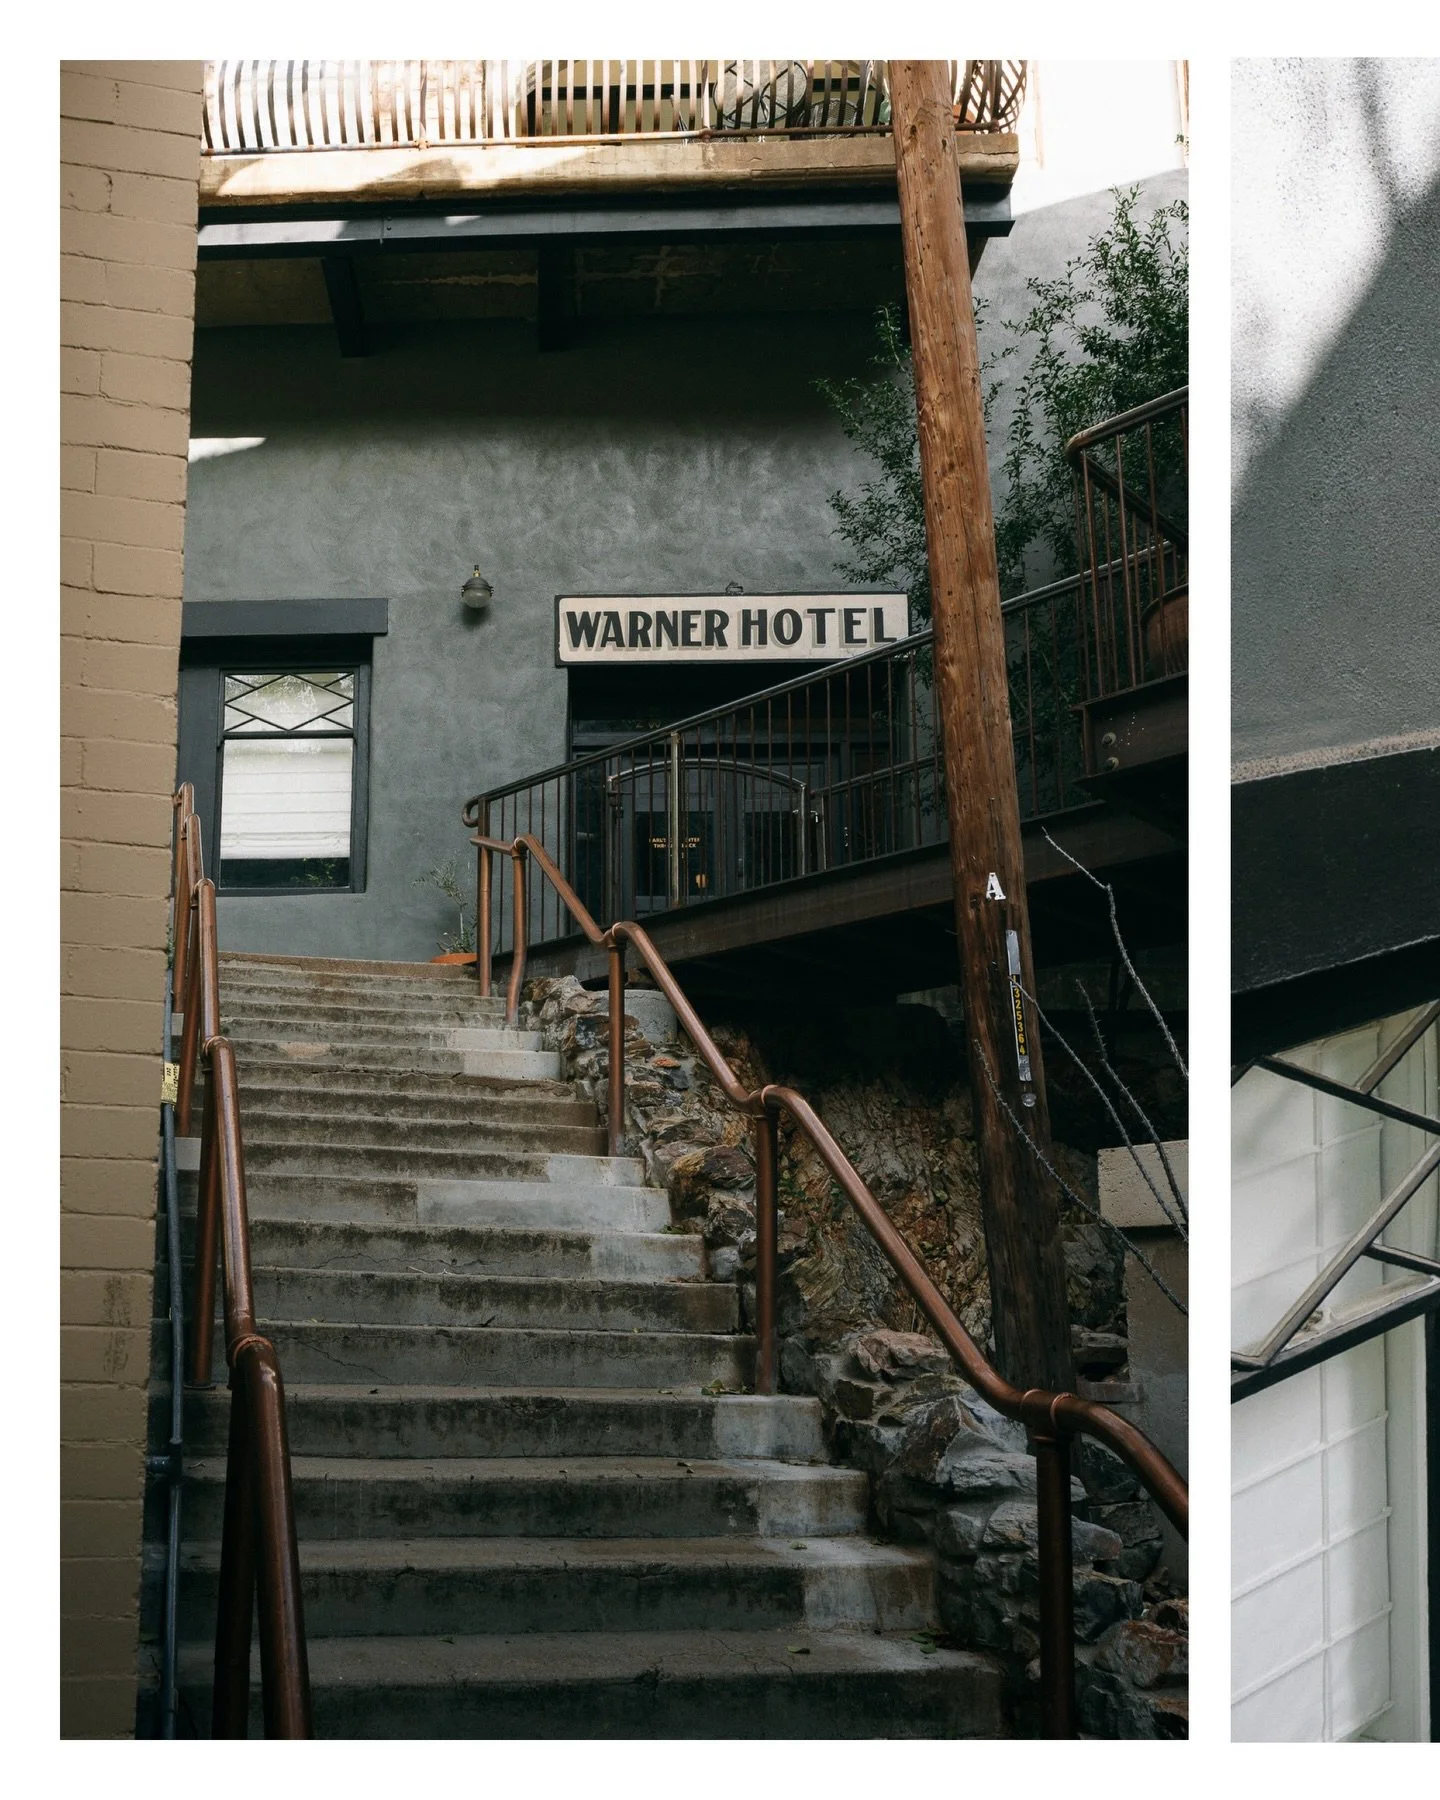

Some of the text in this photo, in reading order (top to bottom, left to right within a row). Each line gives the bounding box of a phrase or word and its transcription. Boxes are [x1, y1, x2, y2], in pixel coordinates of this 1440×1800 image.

[564, 607, 898, 650] WARNER HOTEL
[986, 872, 1006, 900] A
[1012, 974, 1026, 1056] 1325364
